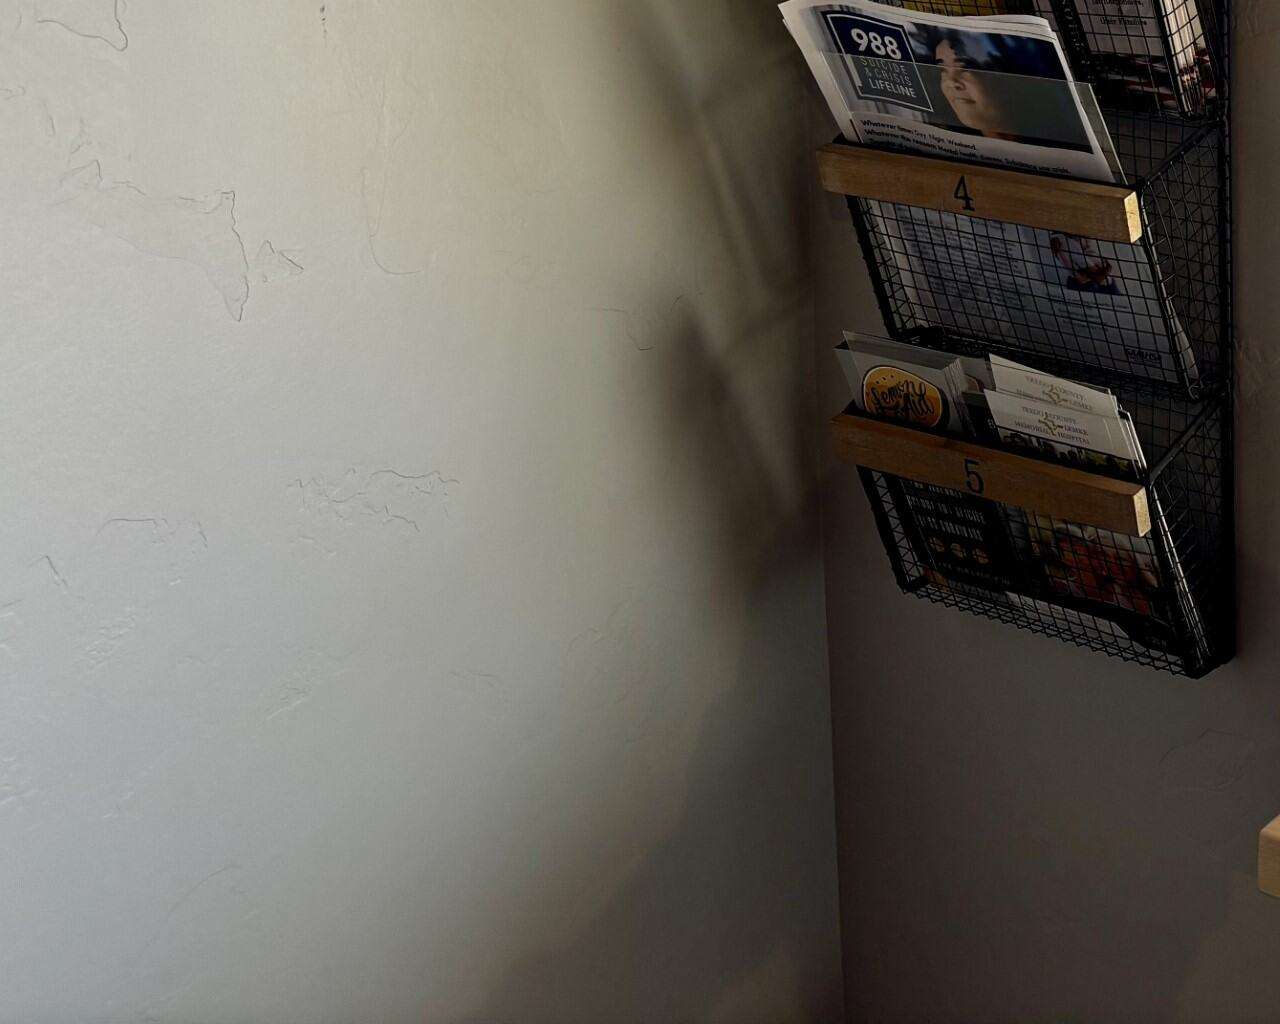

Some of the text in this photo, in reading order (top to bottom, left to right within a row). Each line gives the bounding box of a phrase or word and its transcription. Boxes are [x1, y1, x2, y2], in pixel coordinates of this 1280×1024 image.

[850, 27, 902, 61] 988
[868, 78, 918, 99] LIFELINE
[953, 175, 976, 211] 4
[963, 458, 985, 495] 5
